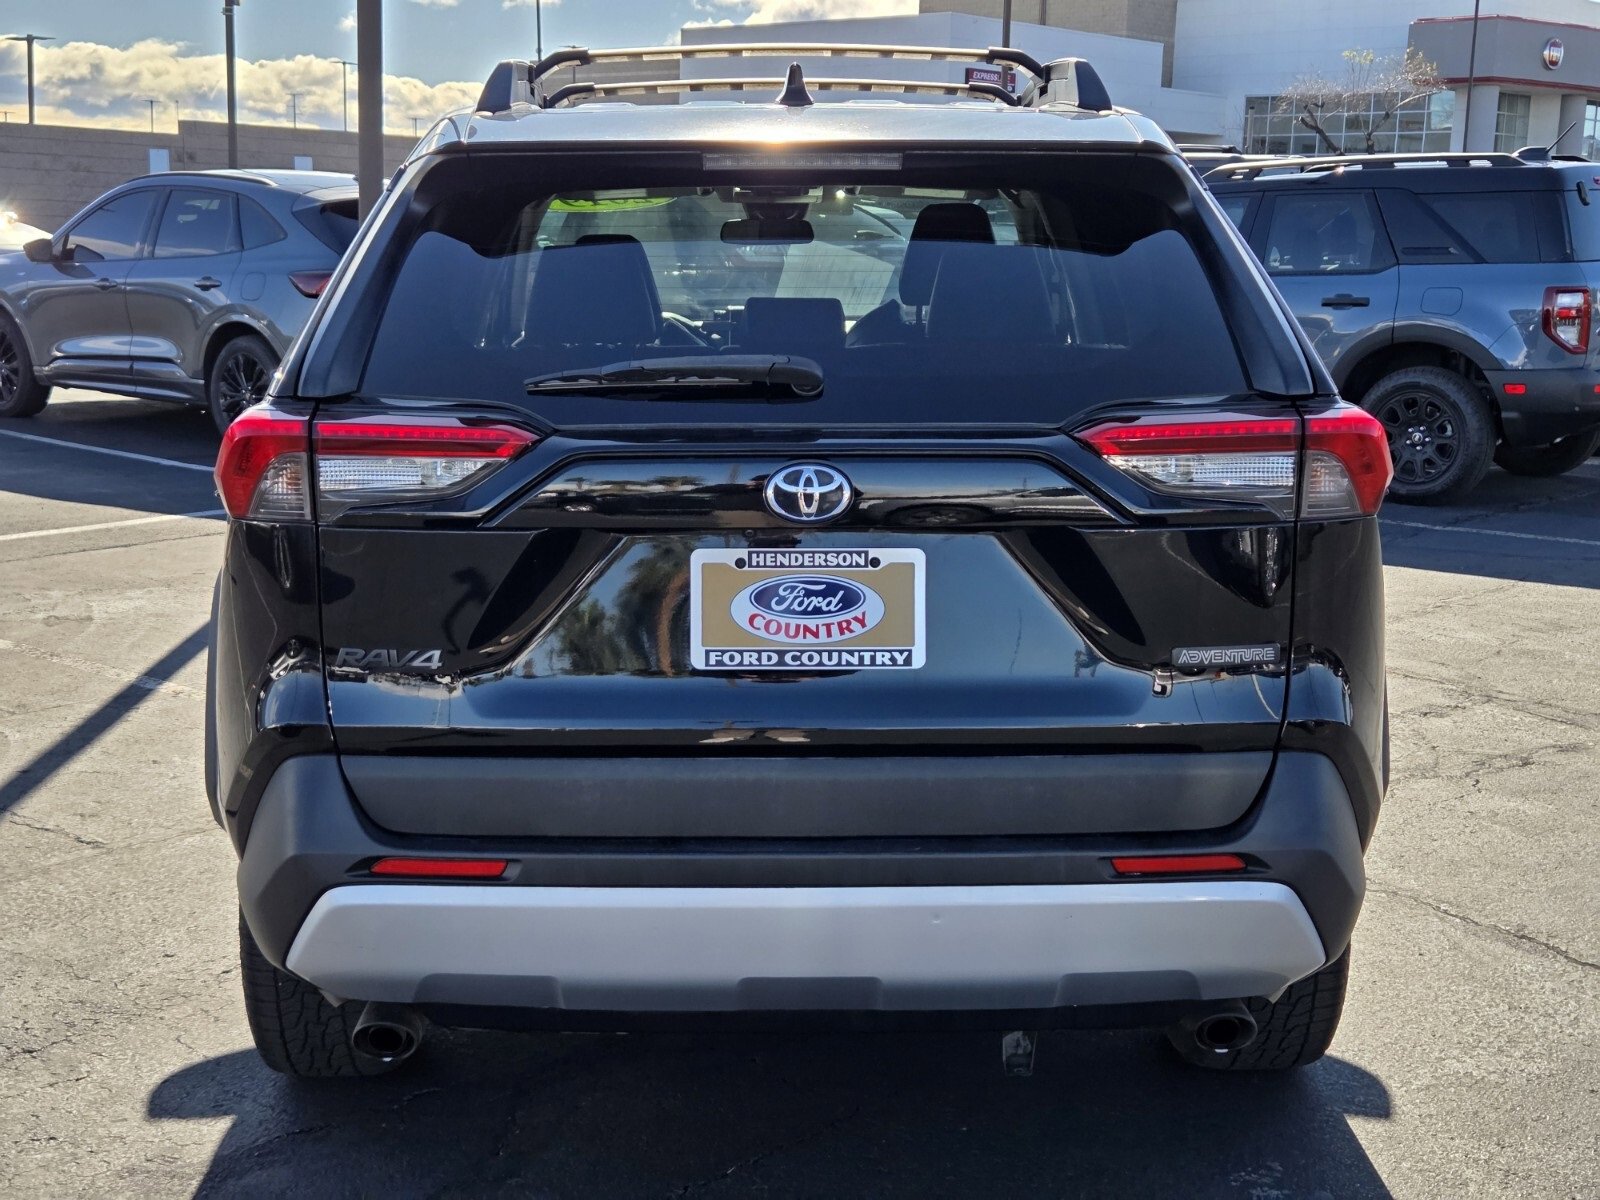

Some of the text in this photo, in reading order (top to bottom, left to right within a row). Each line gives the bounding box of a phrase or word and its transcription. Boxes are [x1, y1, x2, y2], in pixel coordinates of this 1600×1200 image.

[751, 552, 866, 567] HENDERSON
[770, 582, 845, 612] Ford
[747, 611, 868, 640] COUNTRY
[335, 647, 443, 670] RAV4
[708, 651, 910, 666] FORD COUNTRY
[1177, 647, 1276, 665] ADVENTURE
